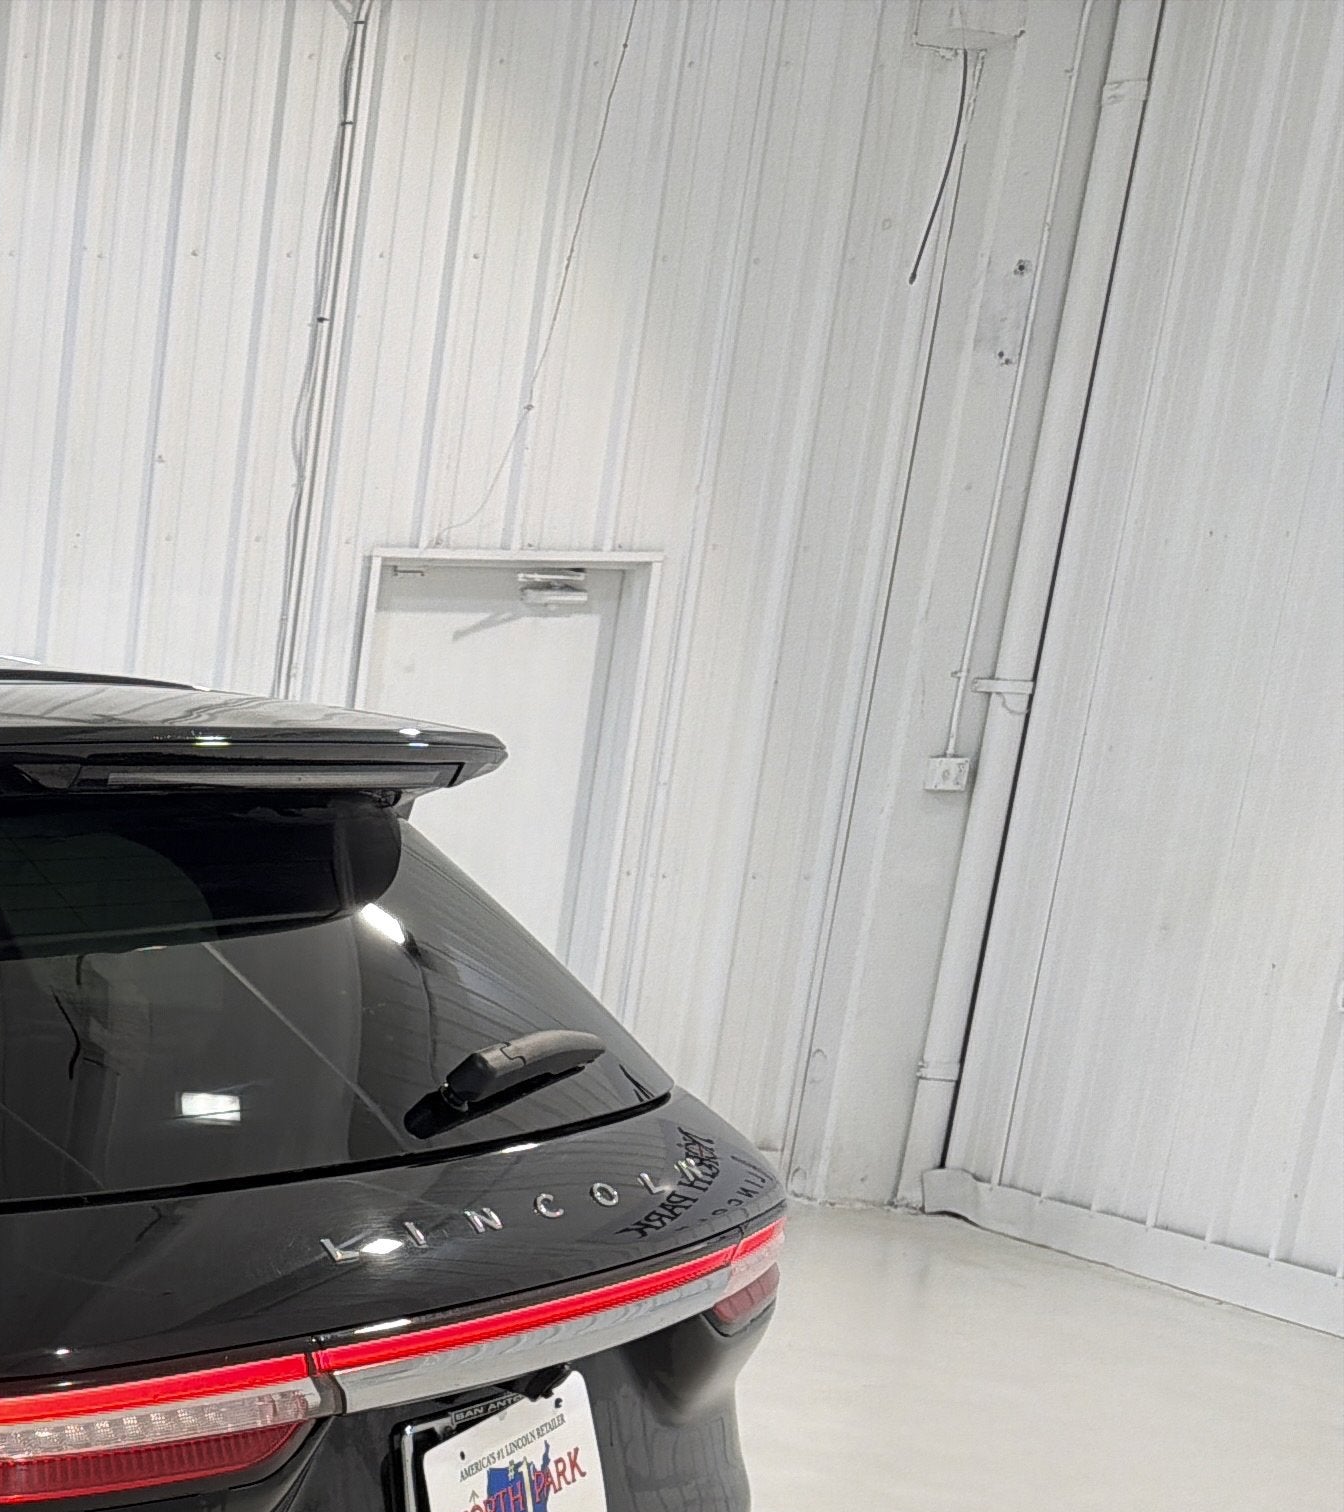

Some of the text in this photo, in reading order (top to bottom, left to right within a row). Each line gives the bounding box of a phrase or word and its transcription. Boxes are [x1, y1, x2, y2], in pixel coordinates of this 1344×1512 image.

[319, 1157, 704, 1263] LINCOLN
[487, 1394, 524, 1413] ANTO
[459, 1452, 497, 1482] AMERICA'S
[505, 1429, 536, 1457] LINCOLN
[535, 1413, 566, 1440] RETAILER
[533, 1446, 587, 1505] PARK
